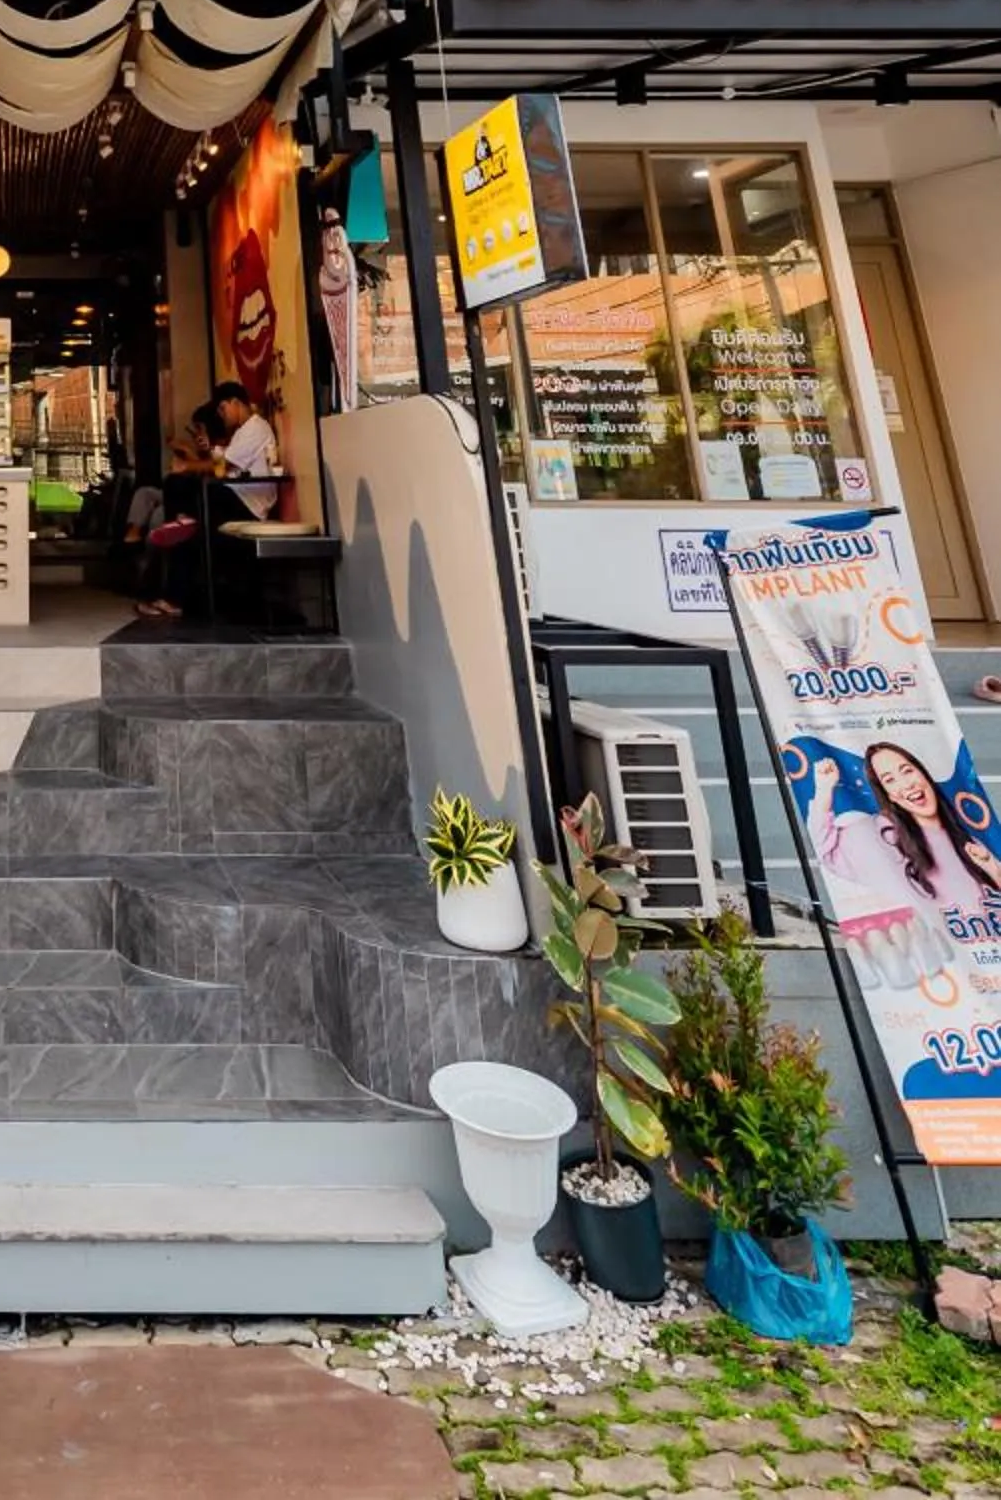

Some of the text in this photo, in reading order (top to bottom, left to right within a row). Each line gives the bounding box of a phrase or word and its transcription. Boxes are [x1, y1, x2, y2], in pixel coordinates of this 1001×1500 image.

[711, 329, 805, 346] ยินดีต้อนรับ
[718, 350, 806, 365] Welcome
[743, 566, 869, 603] IMPLANT
[787, 666, 913, 702] 20,000.-
[928, 1026, 1001, 1068] 12,0
